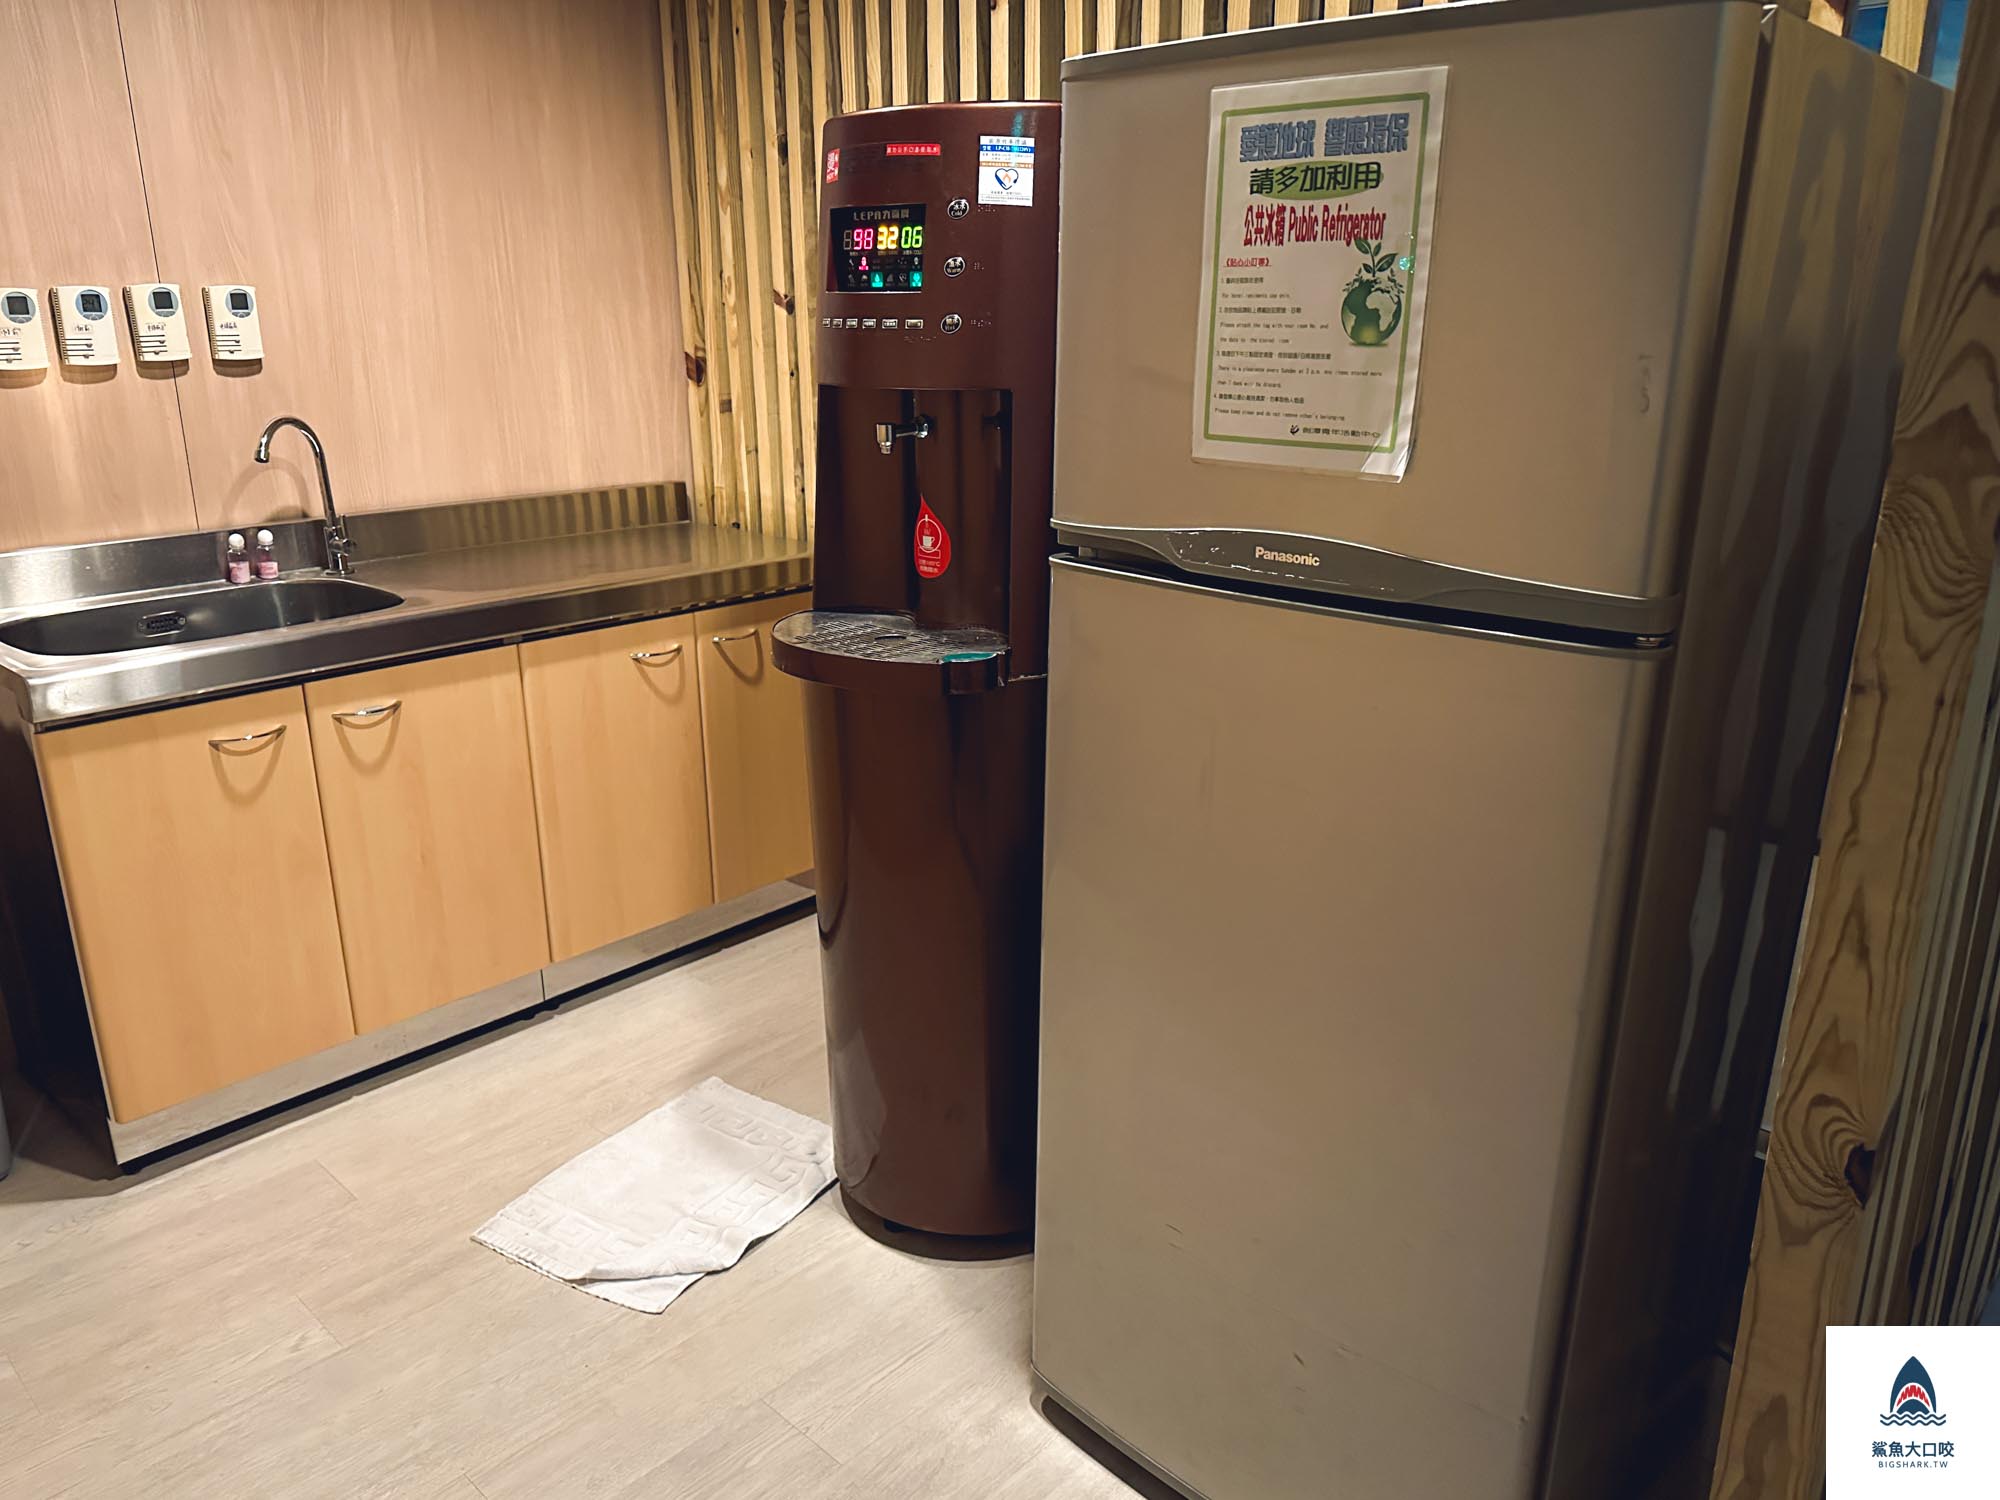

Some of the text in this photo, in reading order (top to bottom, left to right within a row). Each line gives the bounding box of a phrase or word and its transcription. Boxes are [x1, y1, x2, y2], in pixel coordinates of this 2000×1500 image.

[1240, 112, 1410, 162] 愛護地球 響應環保
[1250, 161, 1381, 195] 請多加利用
[853, 225, 923, 250] 98 32 06
[1244, 203, 1386, 247] 公共冰箱 Public Refrigerator
[1254, 545, 1321, 567] Panasonic
